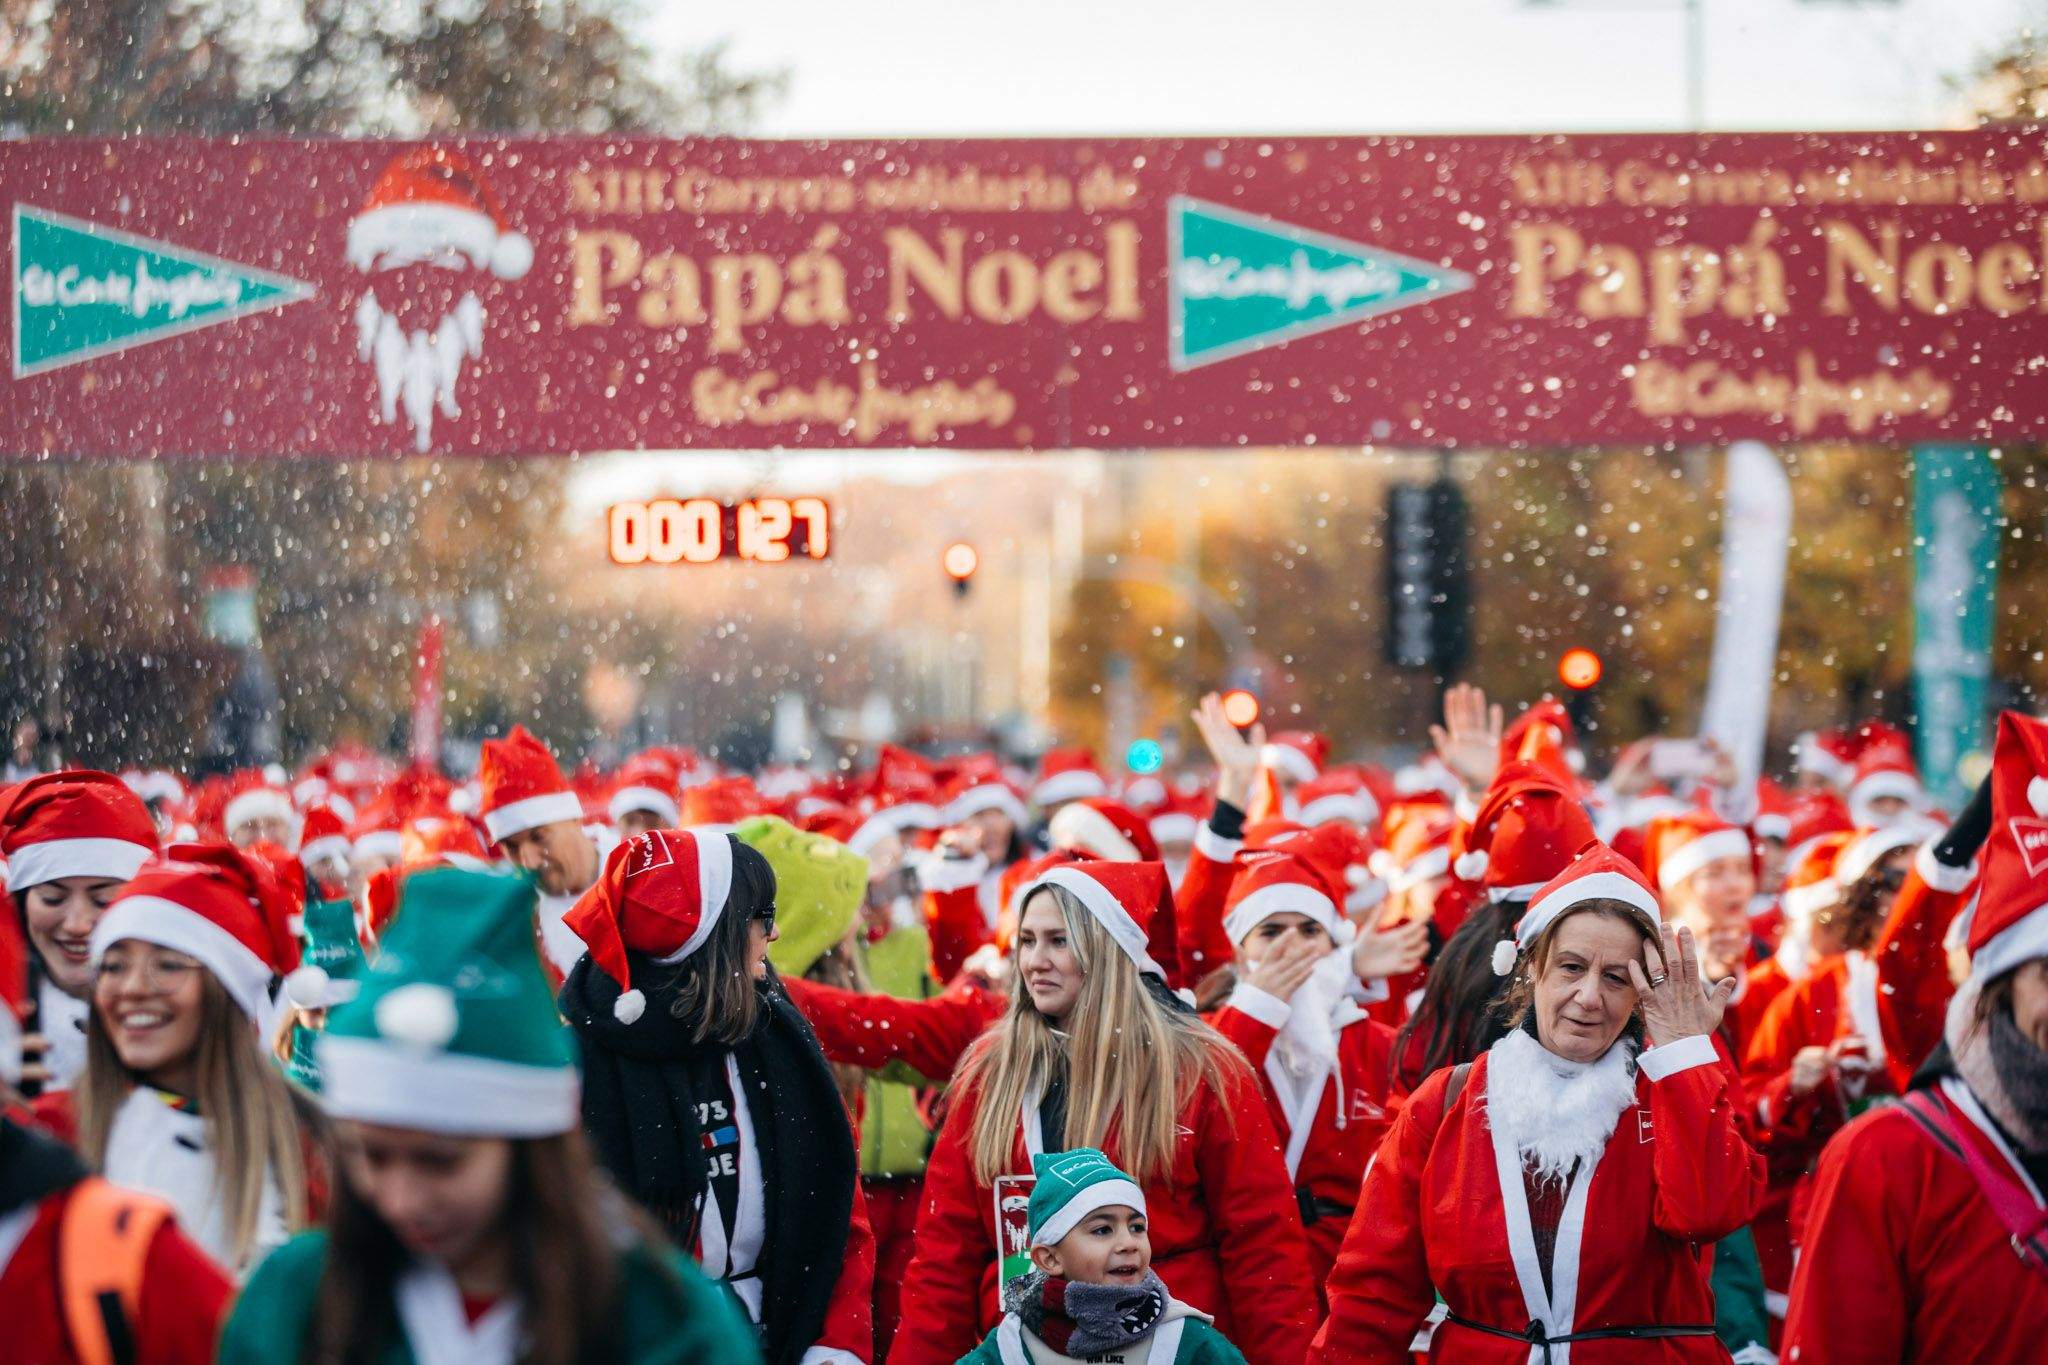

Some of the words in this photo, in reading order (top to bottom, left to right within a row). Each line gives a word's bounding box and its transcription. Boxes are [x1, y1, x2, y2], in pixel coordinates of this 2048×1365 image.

[567, 222, 851, 352] Papá
[885, 217, 1143, 322] Noel
[1509, 214, 1791, 345] Papá
[1822, 212, 2048, 316] Noe
